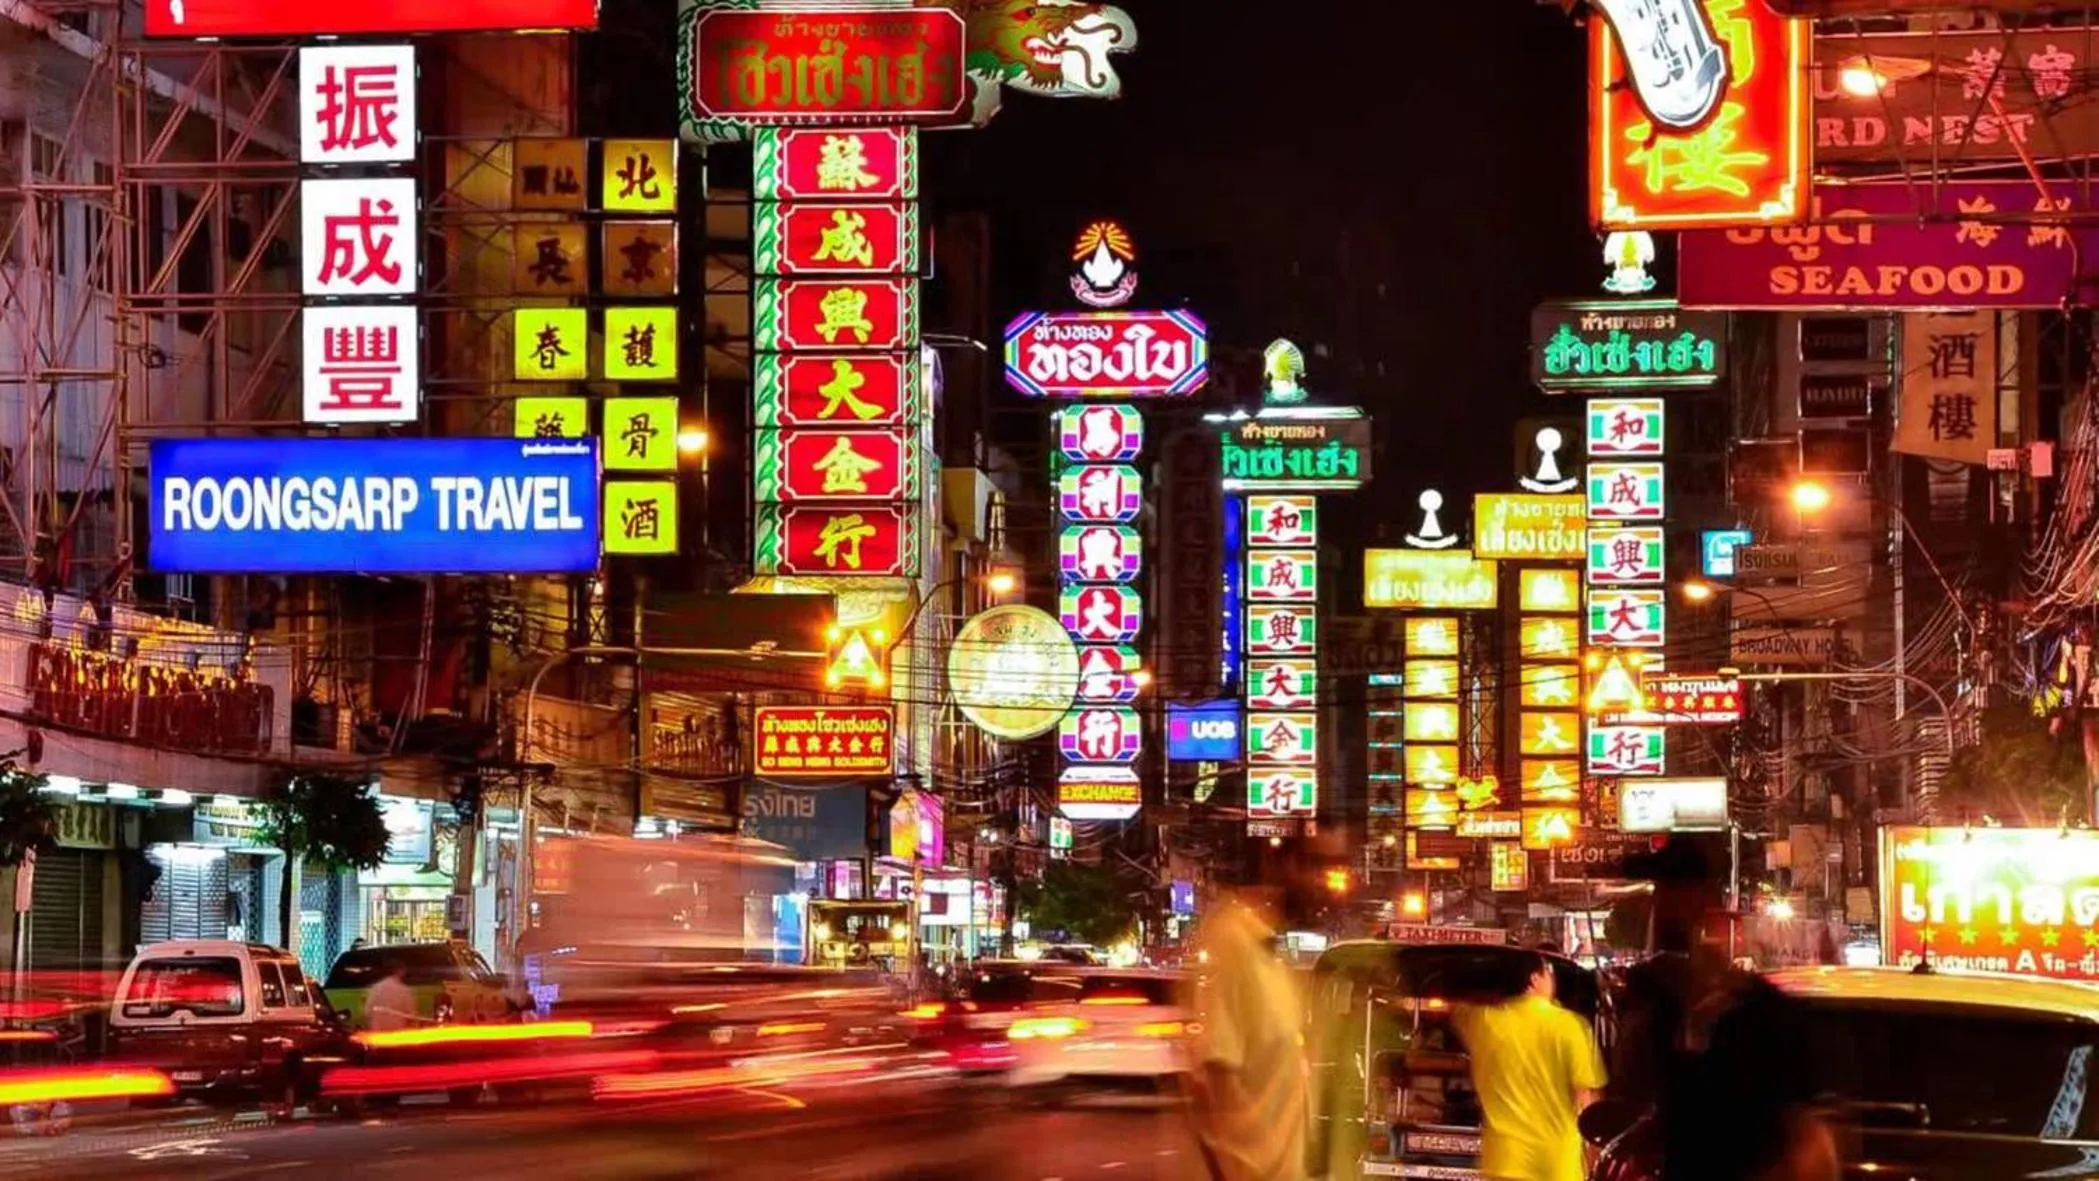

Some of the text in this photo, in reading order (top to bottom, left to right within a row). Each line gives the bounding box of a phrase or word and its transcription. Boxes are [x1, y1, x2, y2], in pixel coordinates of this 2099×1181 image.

[1817, 114, 2034, 146] RD NEST
[315, 64, 404, 411] 振成豐
[1770, 265, 2024, 296] SEAFOOD
[811, 135, 885, 570] 蘇成興大金行
[1928, 312, 1979, 442] 酒樓
[164, 474, 583, 532] ROONGSARP TRAVEL
[1608, 411, 1644, 766] 和成興大行
[1192, 720, 1236, 740] UOB
[1060, 783, 1138, 801] EXCHANGE
